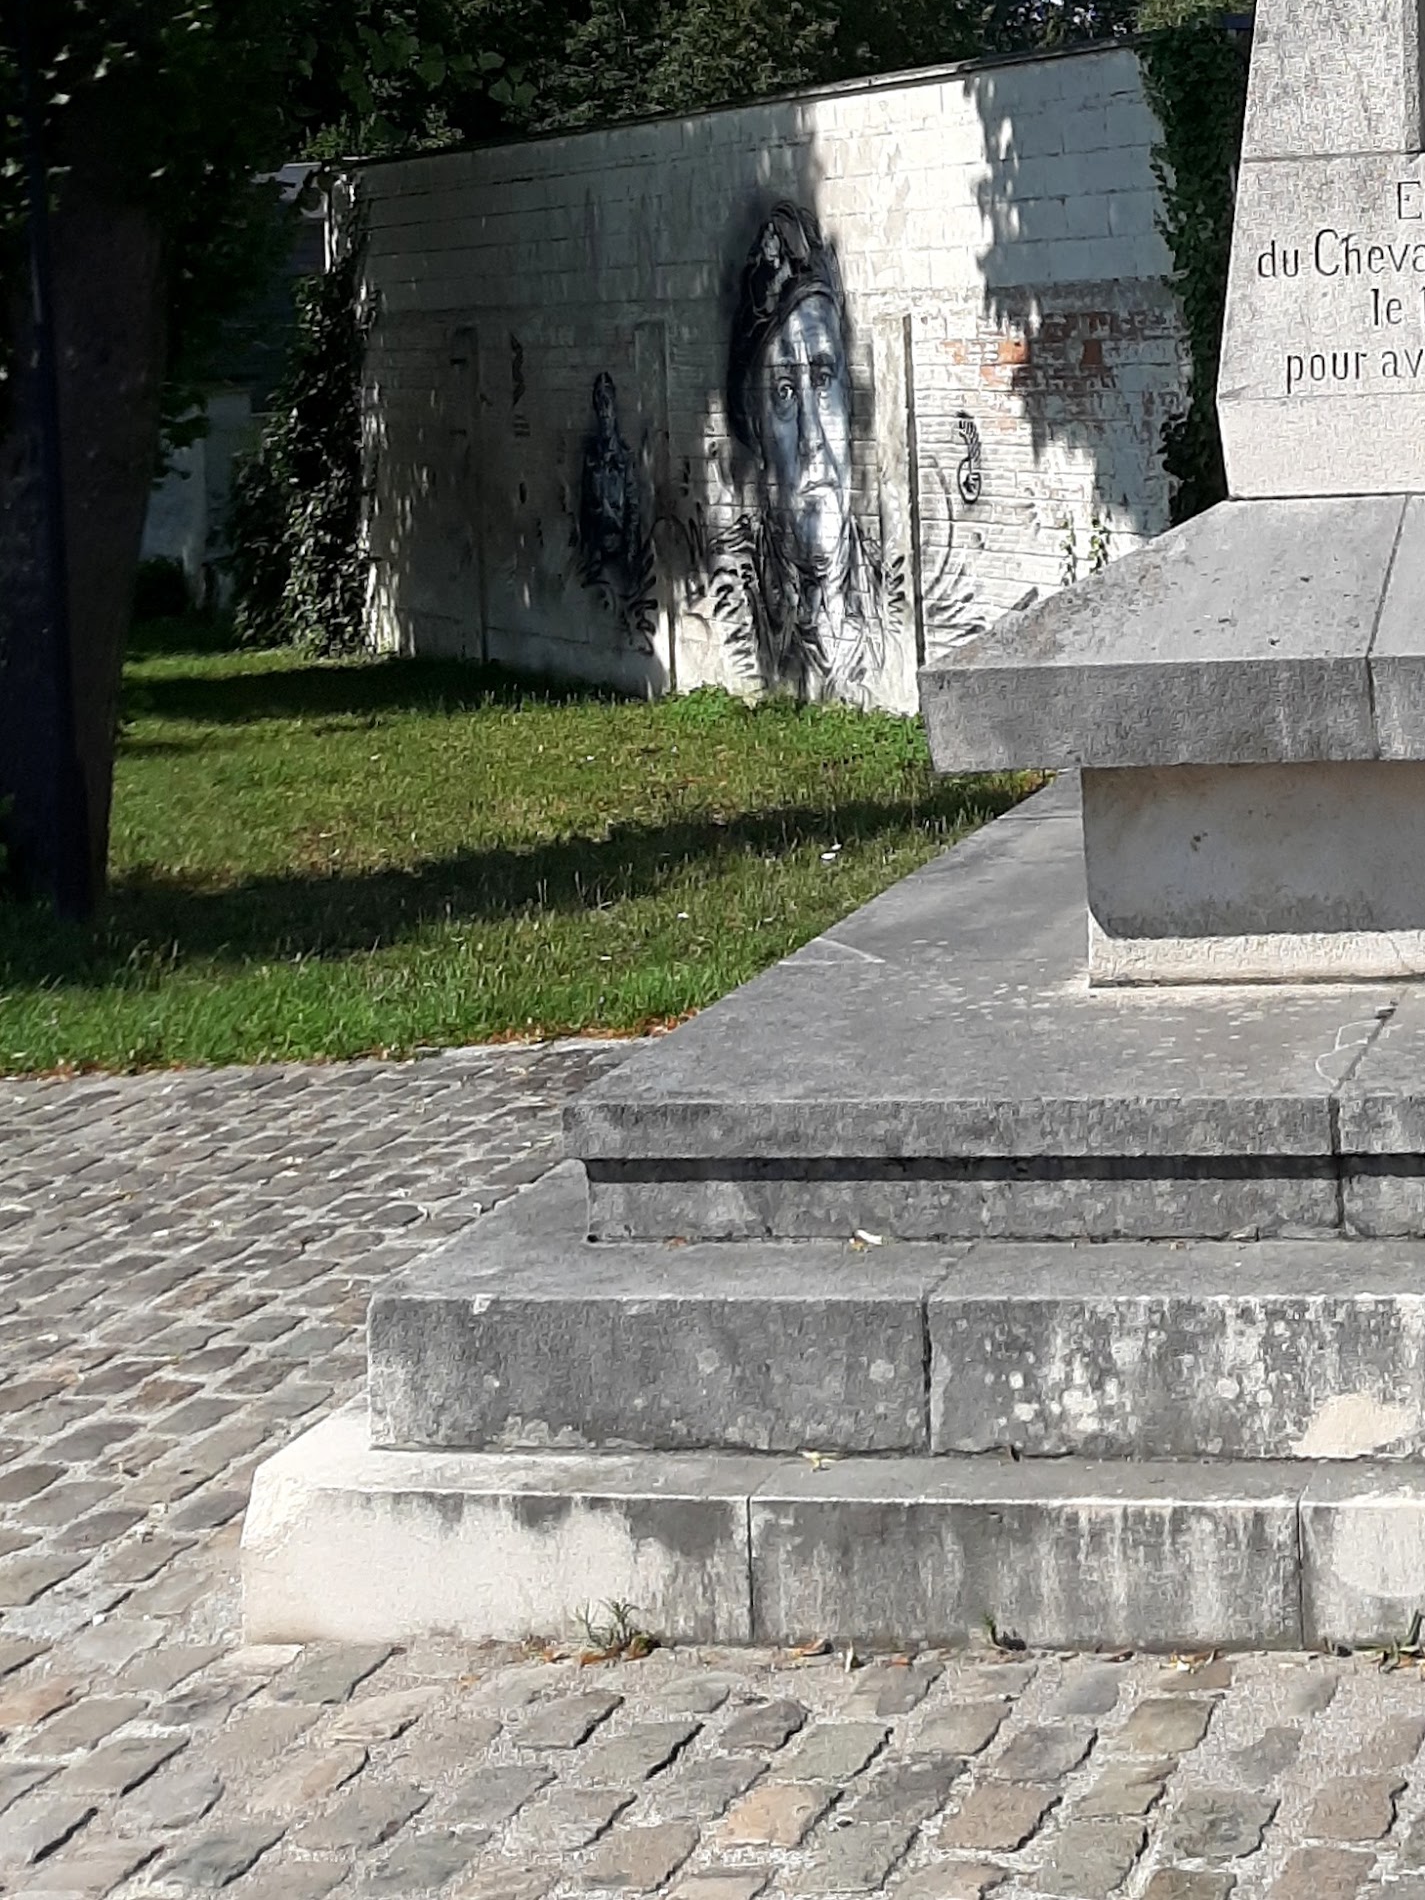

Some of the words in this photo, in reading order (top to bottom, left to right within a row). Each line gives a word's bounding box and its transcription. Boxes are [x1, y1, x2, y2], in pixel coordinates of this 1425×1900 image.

[1257, 240, 1299, 278] du
[1371, 288, 1402, 326] le
[1286, 349, 1368, 395] pour
